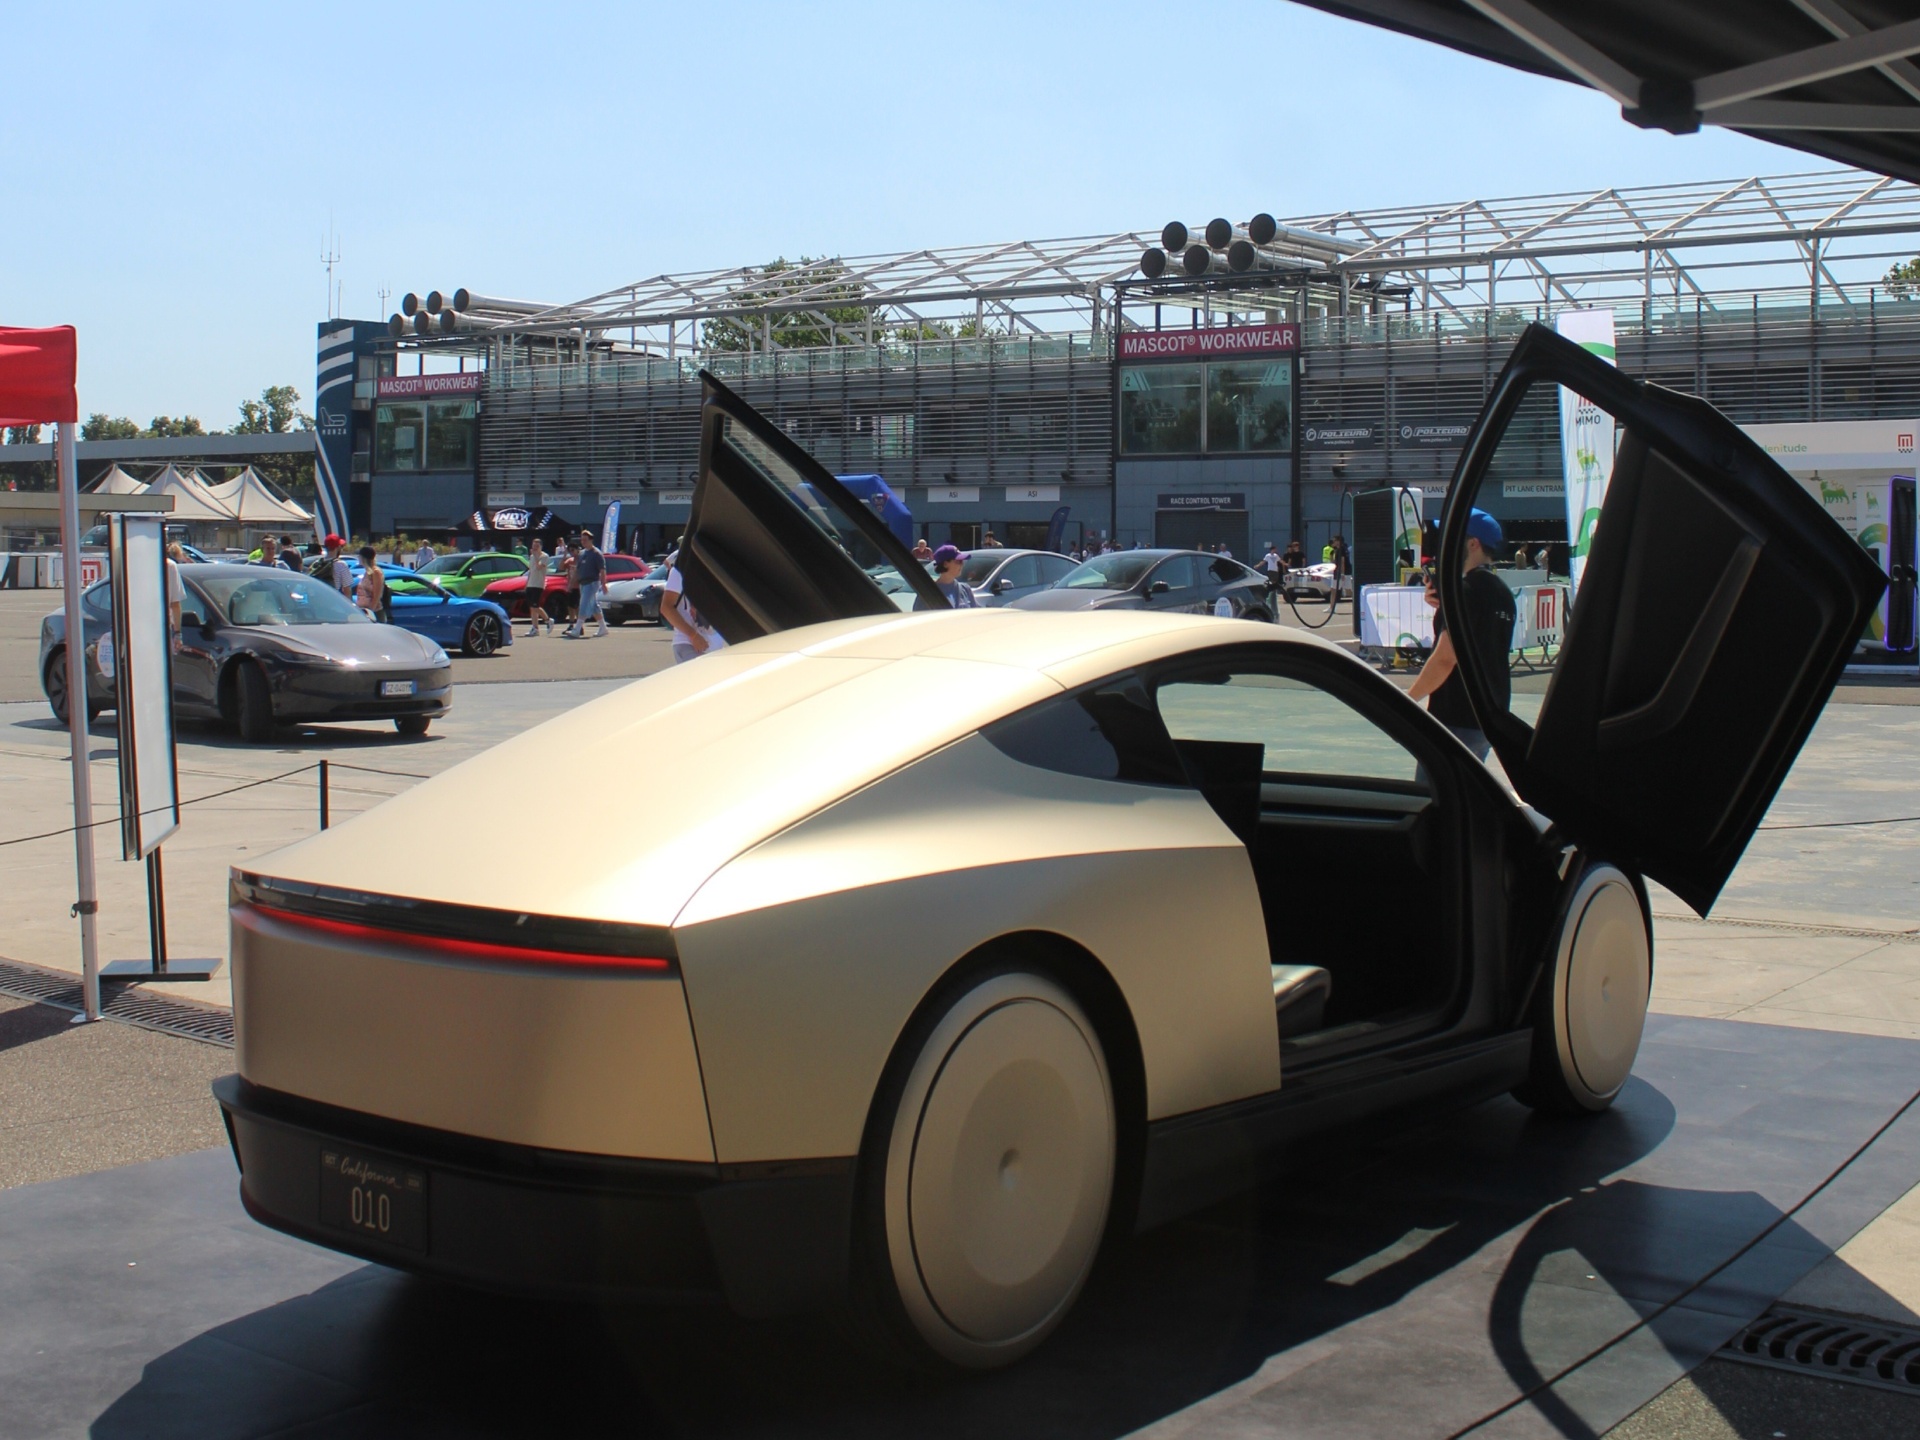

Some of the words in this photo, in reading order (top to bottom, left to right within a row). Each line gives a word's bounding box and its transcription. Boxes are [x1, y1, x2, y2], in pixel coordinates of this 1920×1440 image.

[1199, 329, 1293, 350] WORKWEAR
[1281, 369, 1288, 381] 2
[1125, 376, 1131, 387] 2
[1576, 414, 1601, 426] MIMO
[1761, 443, 1807, 453] lenitude
[1028, 490, 1038, 498] ASI
[1428, 485, 1446, 493] LANE
[1505, 485, 1516, 493] PIT
[1517, 485, 1534, 493] LANE
[1170, 497, 1184, 505] RACE
[1185, 497, 1211, 505] CONTROL
[340, 1157, 402, 1189] California
[352, 1187, 390, 1232] 010
